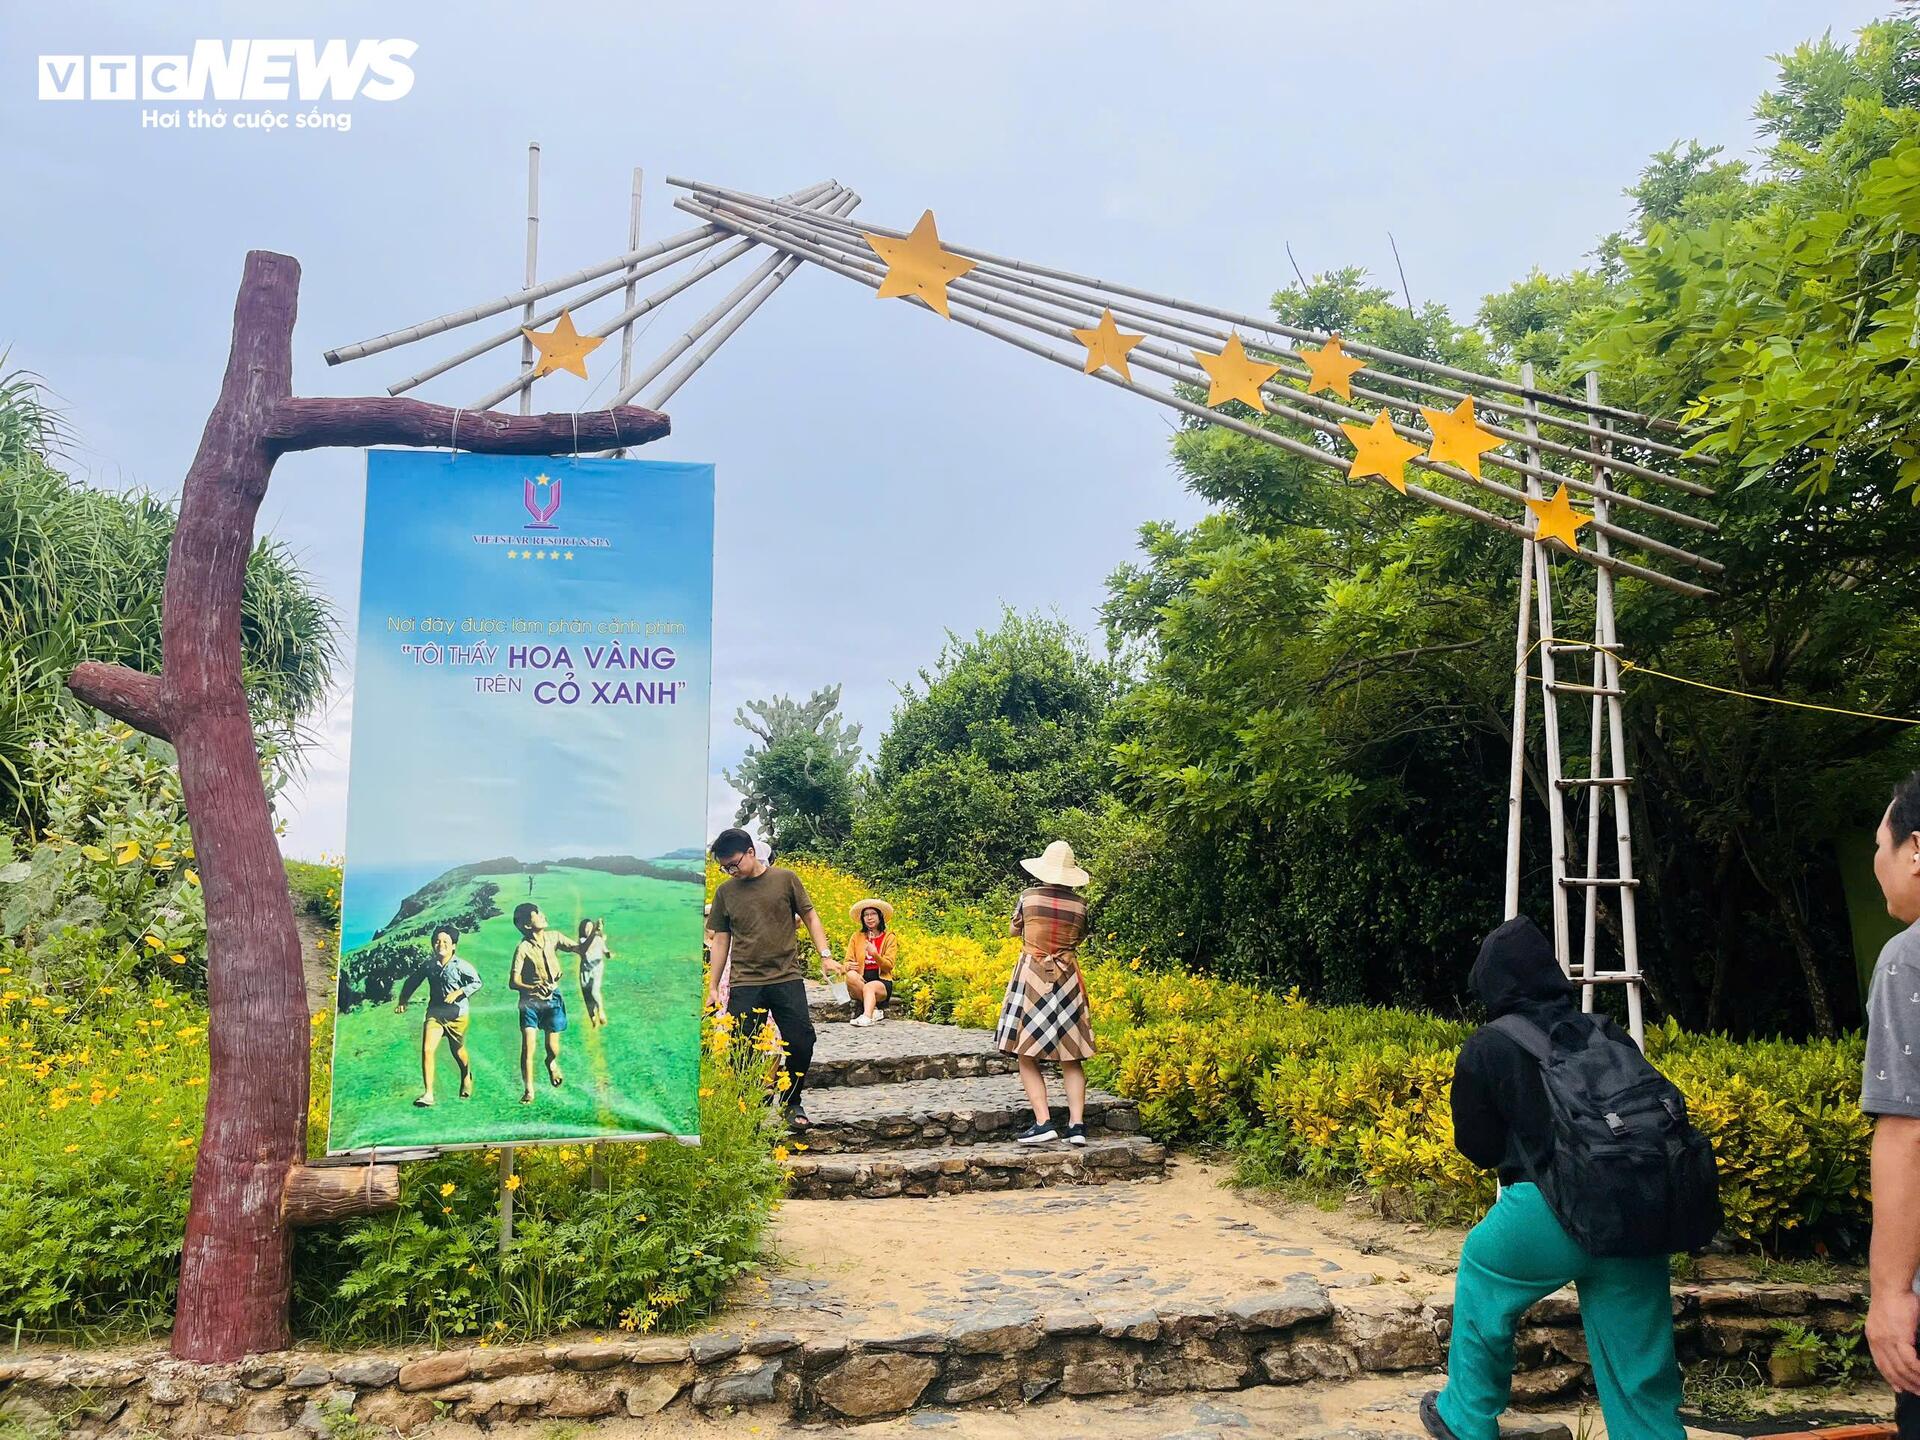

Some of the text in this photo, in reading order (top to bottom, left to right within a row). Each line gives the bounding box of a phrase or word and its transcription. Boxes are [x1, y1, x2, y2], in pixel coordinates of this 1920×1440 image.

[473, 535, 611, 547] VIETSTAR RESORT & SPA
[387, 615, 685, 637] Nơi đây được làm phân cảnh phim
[450, 640, 498, 664] THẤY
[508, 645, 575, 669] HOA
[584, 640, 676, 670] VÀNG
[475, 674, 522, 693] TRÊN
[533, 672, 581, 705] CỎ
